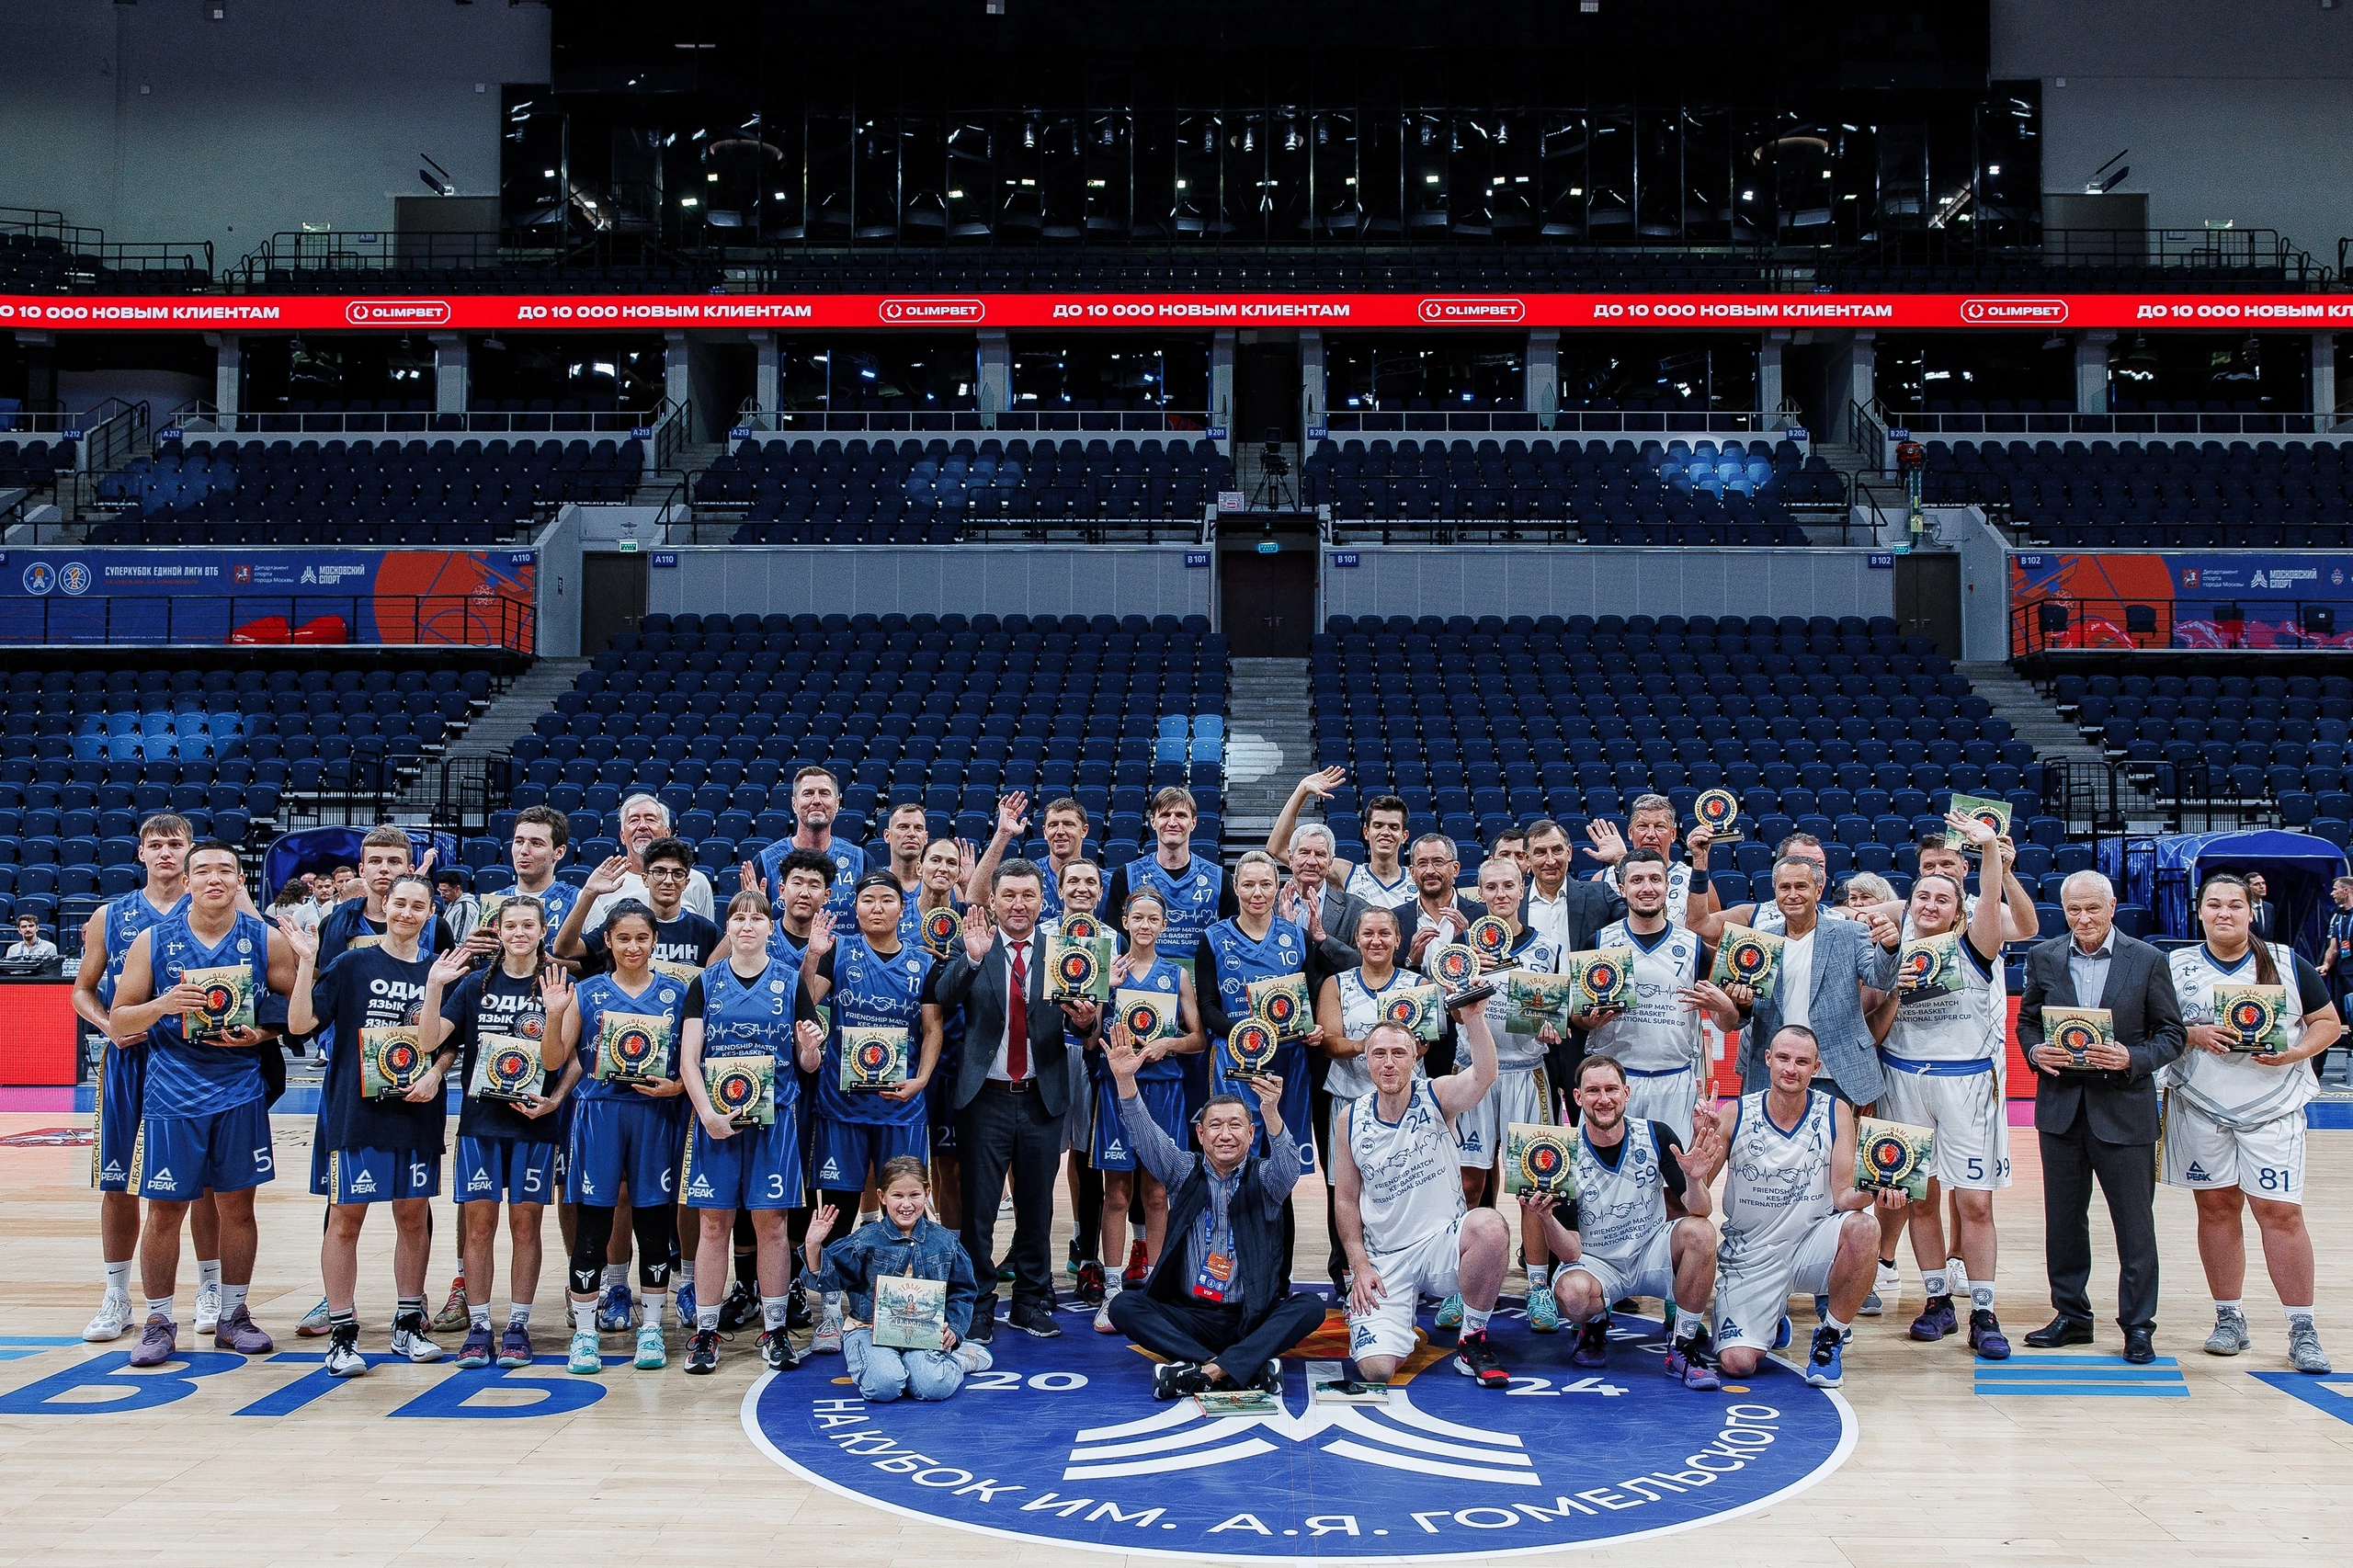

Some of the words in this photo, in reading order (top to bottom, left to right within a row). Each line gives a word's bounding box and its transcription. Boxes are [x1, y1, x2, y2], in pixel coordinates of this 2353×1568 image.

[0, 305, 15, 317] О
[19, 306, 42, 318] 10
[46, 307, 88, 318] 000
[92, 307, 168, 318] НОВЫМ
[173, 307, 279, 318] КЛИЕНТАМ
[372, 308, 443, 318] OLIMPBET
[517, 306, 547, 320] ДО
[551, 306, 572, 318] 10
[576, 306, 619, 318] 000
[622, 306, 699, 318] НОВЫМ
[703, 306, 811, 317] КЛИЕНТАМ
[906, 306, 978, 317] OLIMPBET
[1053, 305, 1083, 318] ДО
[1086, 305, 1108, 317] 10
[1112, 305, 1154, 317] 000
[1159, 305, 1237, 316] НОВЫМ
[1241, 305, 1350, 316] КЛИЕНТАМ
[1445, 306, 1518, 316] OLIMPBET
[1594, 305, 1623, 318] ДО
[1627, 305, 1649, 317] 10
[1653, 305, 1696, 317] 000
[1700, 305, 1779, 317] НОВЫМ
[1782, 305, 1893, 317] КЛИЕНТАМ
[1987, 307, 2061, 317] OLIMPBET
[2137, 305, 2168, 319] ДО
[2171, 305, 2194, 318] 10
[2197, 305, 2241, 318] 000
[2244, 305, 2324, 318] НОВЫМ
[105, 567, 152, 576] СУПЕРКУБОК
[153, 565, 182, 577] ЕДИНОЙ
[184, 567, 203, 576] ЛИГИ
[319, 564, 365, 575] МОСКОВСКИЙ
[2269, 568, 2317, 579] МОСКОВСКИЙ
[319, 575, 341, 585] СПОРТ
[2269, 579, 2293, 588] СПОРТ
[835, 871, 854, 886] 14
[1192, 888, 1213, 903] 47
[651, 943, 699, 962] ДИН
[1278, 950, 1298, 966] 10
[1673, 961, 1684, 977] 7
[369, 978, 425, 1000] ОДИ
[907, 976, 921, 994] 11
[367, 999, 406, 1012] ЯЗЫК
[771, 997, 783, 1015] 3
[477, 1013, 514, 1024] ЯЗЫК
[845, 1011, 888, 1023] FRIENDSHIP
[711, 1042, 753, 1051] FRIENDSHIP
[754, 1043, 778, 1052] MATCH
[1406, 1107, 1431, 1134] 24
[1462, 1142, 1483, 1154] PEAK
[253, 1147, 273, 1172] 5
[1104, 1151, 1127, 1161] PEAK
[1410, 1158, 1435, 1171] MATCH
[1967, 1157, 1984, 1180] 5
[102, 1172, 127, 1182] PEAK
[409, 1163, 427, 1187] 15
[524, 1168, 542, 1193] 5
[819, 1170, 841, 1181] PEAK
[1415, 1173, 1436, 1187] SUPER
[1437, 1165, 1447, 1175] CU
[1634, 1165, 1657, 1189] 59
[2186, 1172, 2212, 1182] PEAK
[2258, 1167, 2289, 1192] 81
[147, 1180, 178, 1192] PEAK
[351, 1182, 376, 1194] PEAK
[467, 1181, 493, 1192] PEAK
[688, 1187, 716, 1199] PEAK
[767, 1174, 784, 1199] 3
[1810, 1193, 1824, 1202] CUP
[1590, 1220, 1632, 1237] FRIENDSHIP
[1652, 1216, 1664, 1227] CUP
[1604, 1224, 1646, 1240] KES-BASKET
[1355, 1334, 1378, 1351] PEAK
[1718, 1328, 1744, 1343] PEAK
[964, 1371, 1089, 1392] 20
[1505, 1376, 1631, 1397] 24
[812, 1398, 870, 1431] НА
[828, 1429, 1026, 1504] КУБОК
[1410, 1403, 1782, 1534] ГОМЕЛЬСКОГО
[1018, 1491, 1178, 1530] ИМ.
